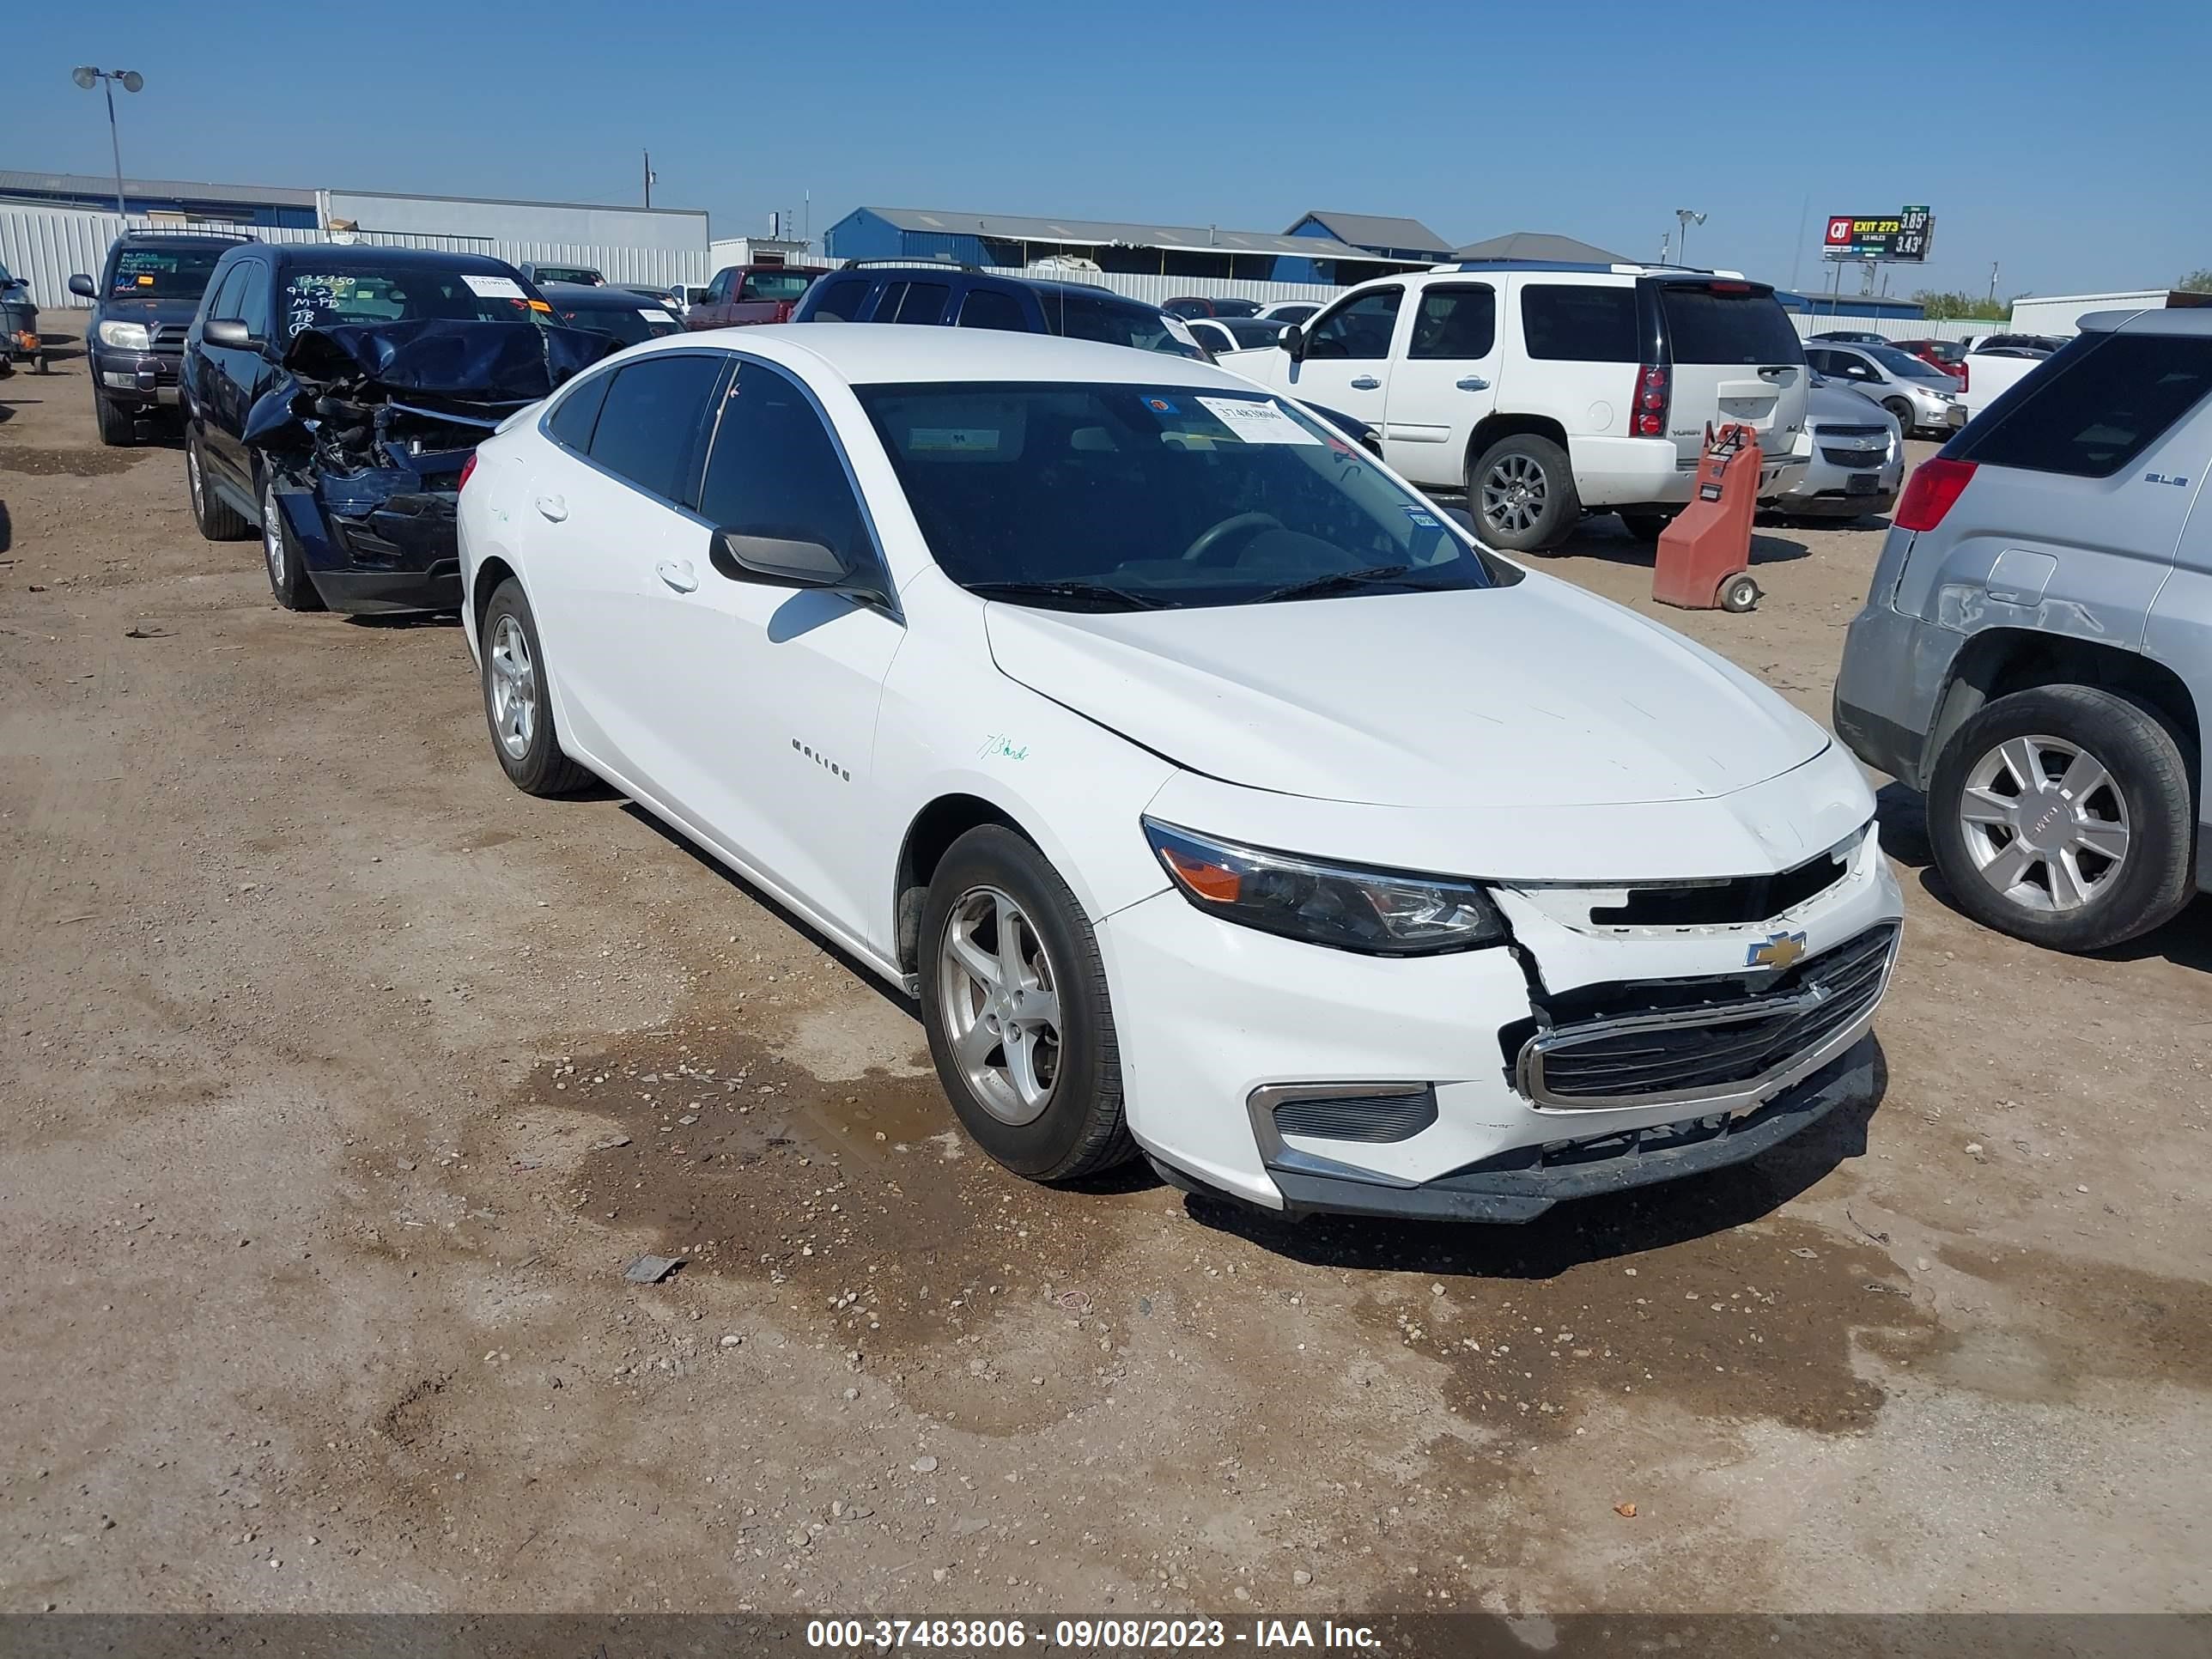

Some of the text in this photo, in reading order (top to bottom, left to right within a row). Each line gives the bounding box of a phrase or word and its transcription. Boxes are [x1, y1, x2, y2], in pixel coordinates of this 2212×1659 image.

[1830, 222, 1849, 239] QT
[1852, 222, 1899, 232] EXIT 273
[286, 286, 337, 299] 9-1-23
[2144, 473, 2189, 487] SLE
[791, 738, 850, 782] MALIBU
